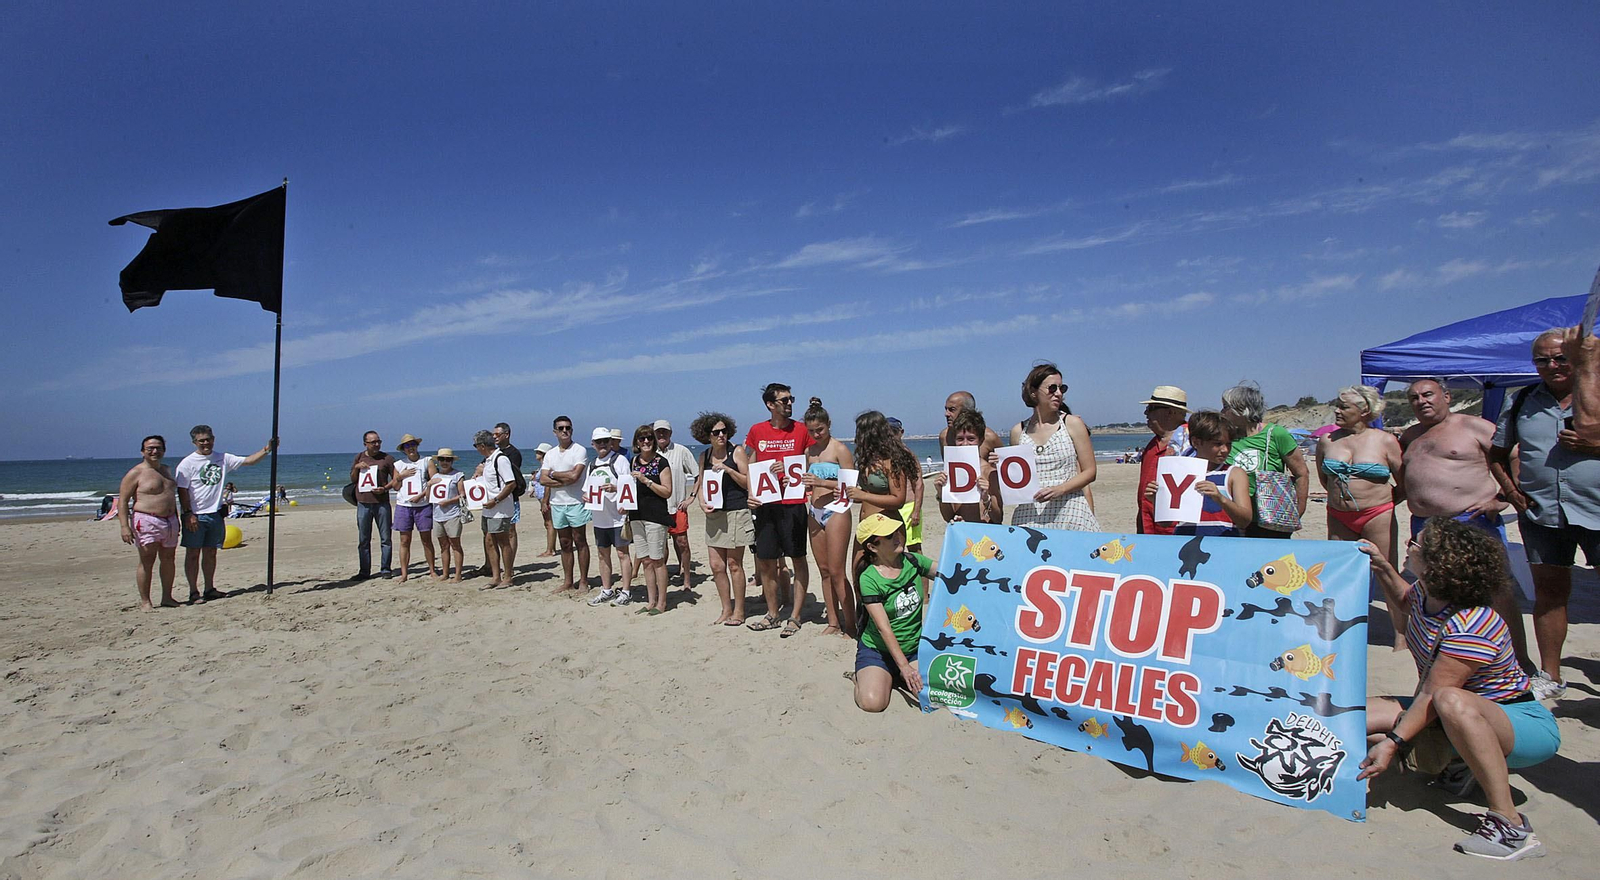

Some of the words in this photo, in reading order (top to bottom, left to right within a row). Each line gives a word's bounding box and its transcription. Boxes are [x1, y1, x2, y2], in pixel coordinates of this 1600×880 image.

[361, 473, 375, 487] A
[756, 472, 777, 497] A
[788, 463, 802, 487] S
[948, 462, 977, 493] D
[1000, 456, 1032, 489] O
[407, 481, 418, 496] L
[433, 484, 447, 499] G
[468, 484, 486, 501] O
[589, 485, 602, 504] H
[618, 483, 634, 503] A
[707, 480, 719, 501] P
[1161, 473, 1197, 509] Y
[1017, 567, 1222, 662] STOP
[1011, 647, 1200, 727] FECALES
[1286, 712, 1342, 751] DELPHIS
